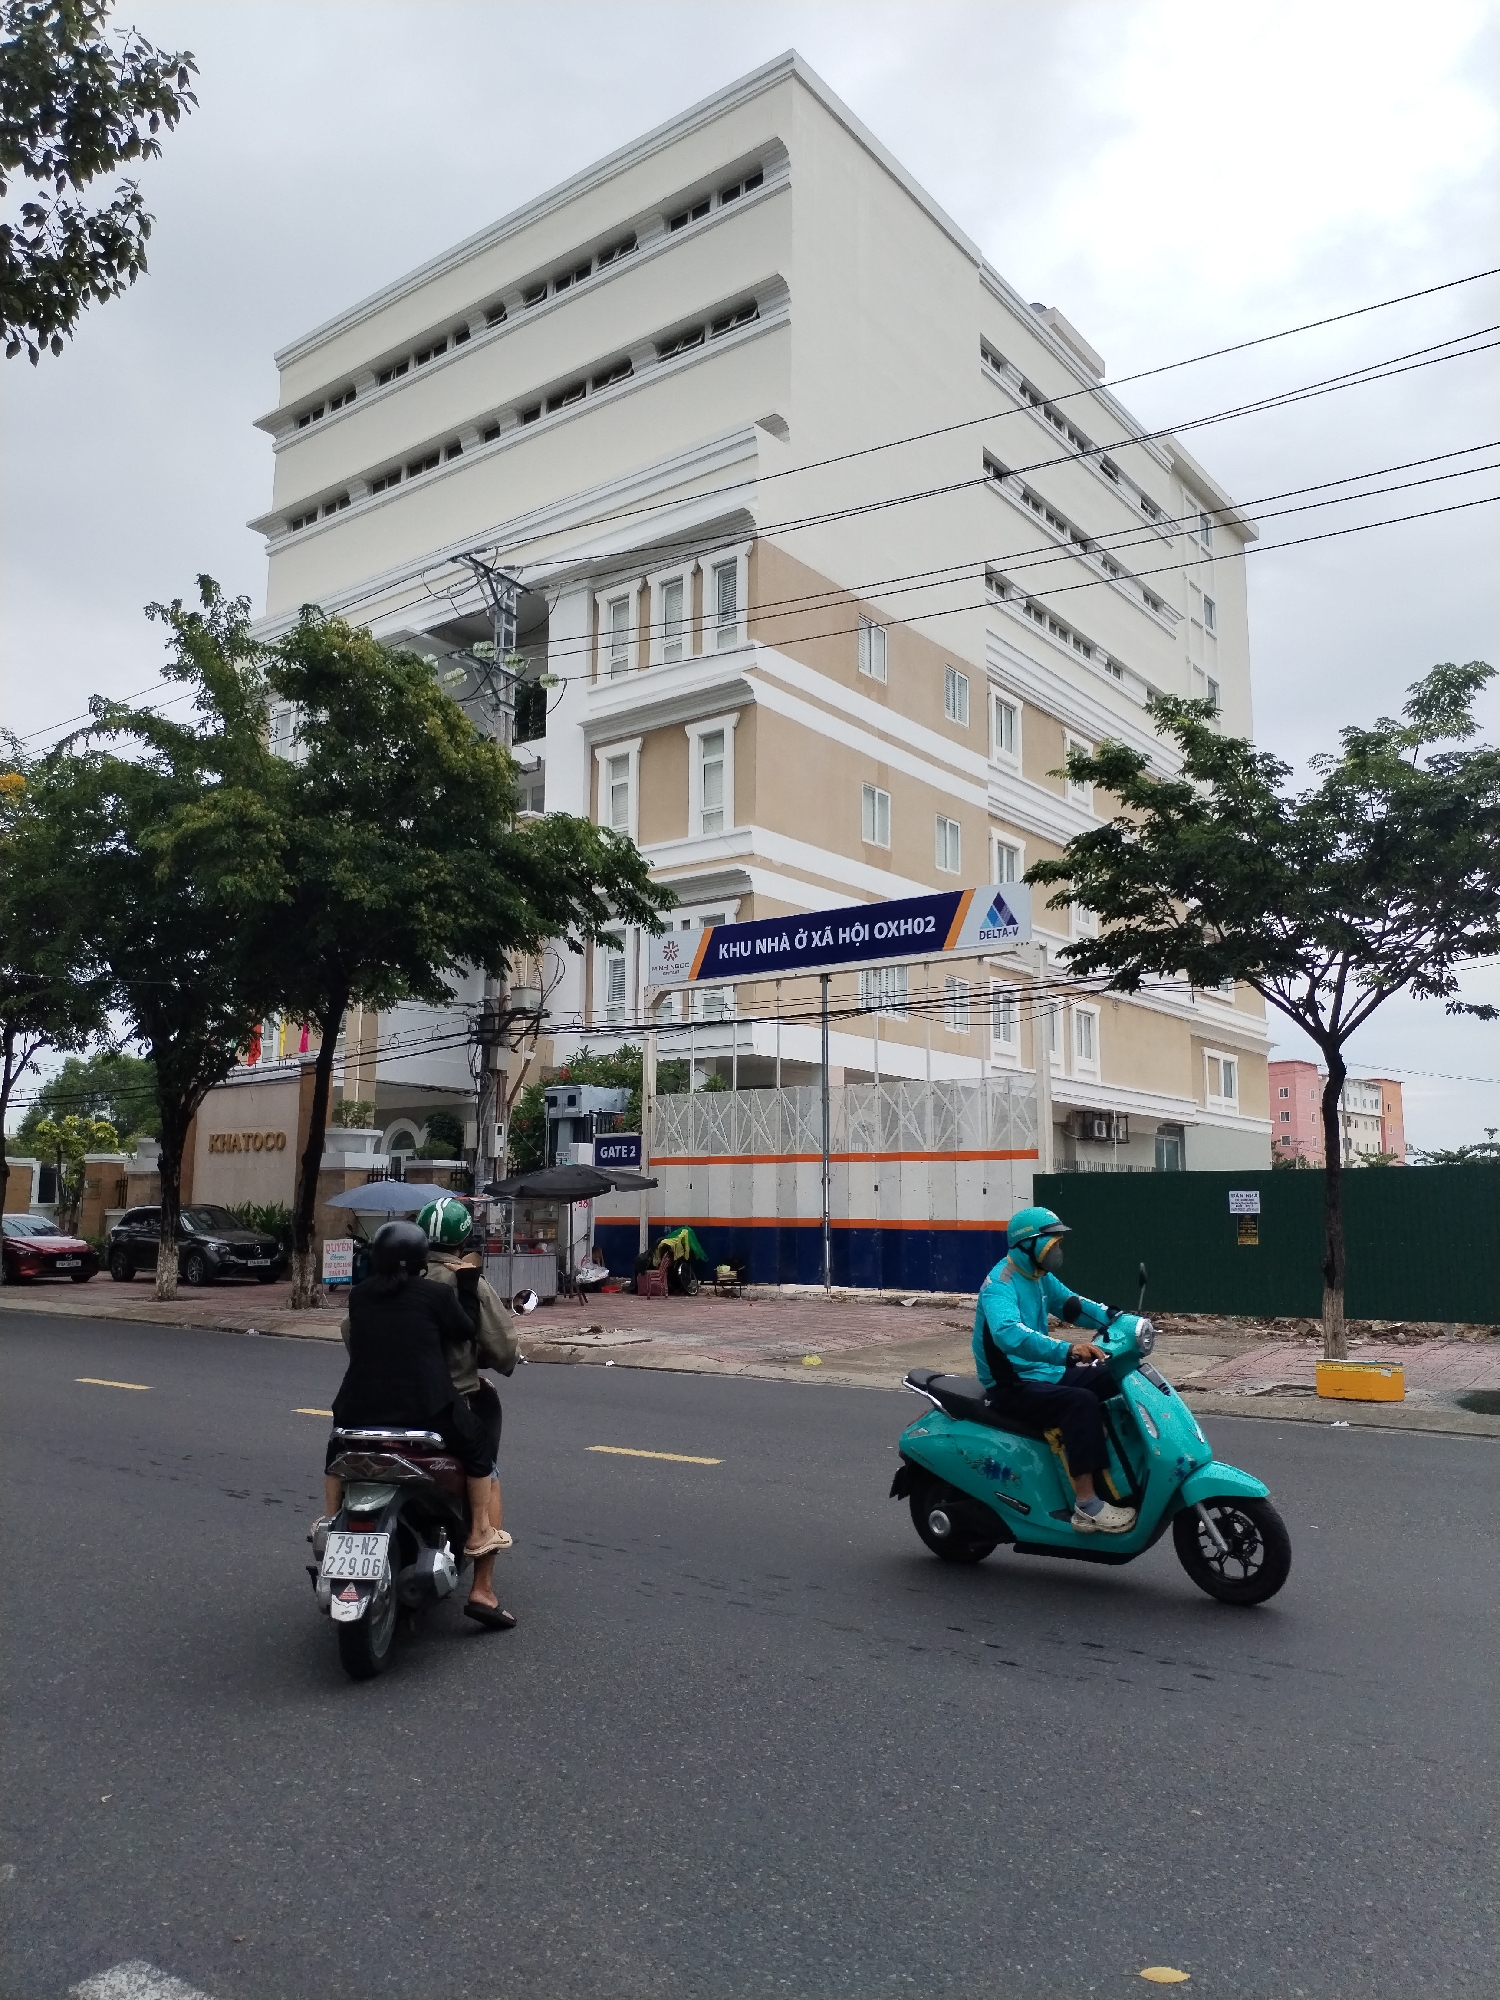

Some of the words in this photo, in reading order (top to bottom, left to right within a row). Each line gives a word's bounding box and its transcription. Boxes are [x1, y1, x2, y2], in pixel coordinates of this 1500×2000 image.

[719, 940, 752, 959] KHU
[755, 932, 791, 955] NHÀ
[794, 927, 808, 949] Ở
[811, 925, 834, 948] XÃ
[838, 921, 870, 947] HỘI
[873, 915, 936, 939] OXH02
[979, 926, 1019, 940] DELTA-V
[208, 1131, 287, 1152] KHATOCO
[600, 1145, 628, 1158] GATE
[629, 1145, 636, 1157] 2
[336, 1535, 379, 1556] 79-N2
[325, 1557, 382, 1577] 229.06
